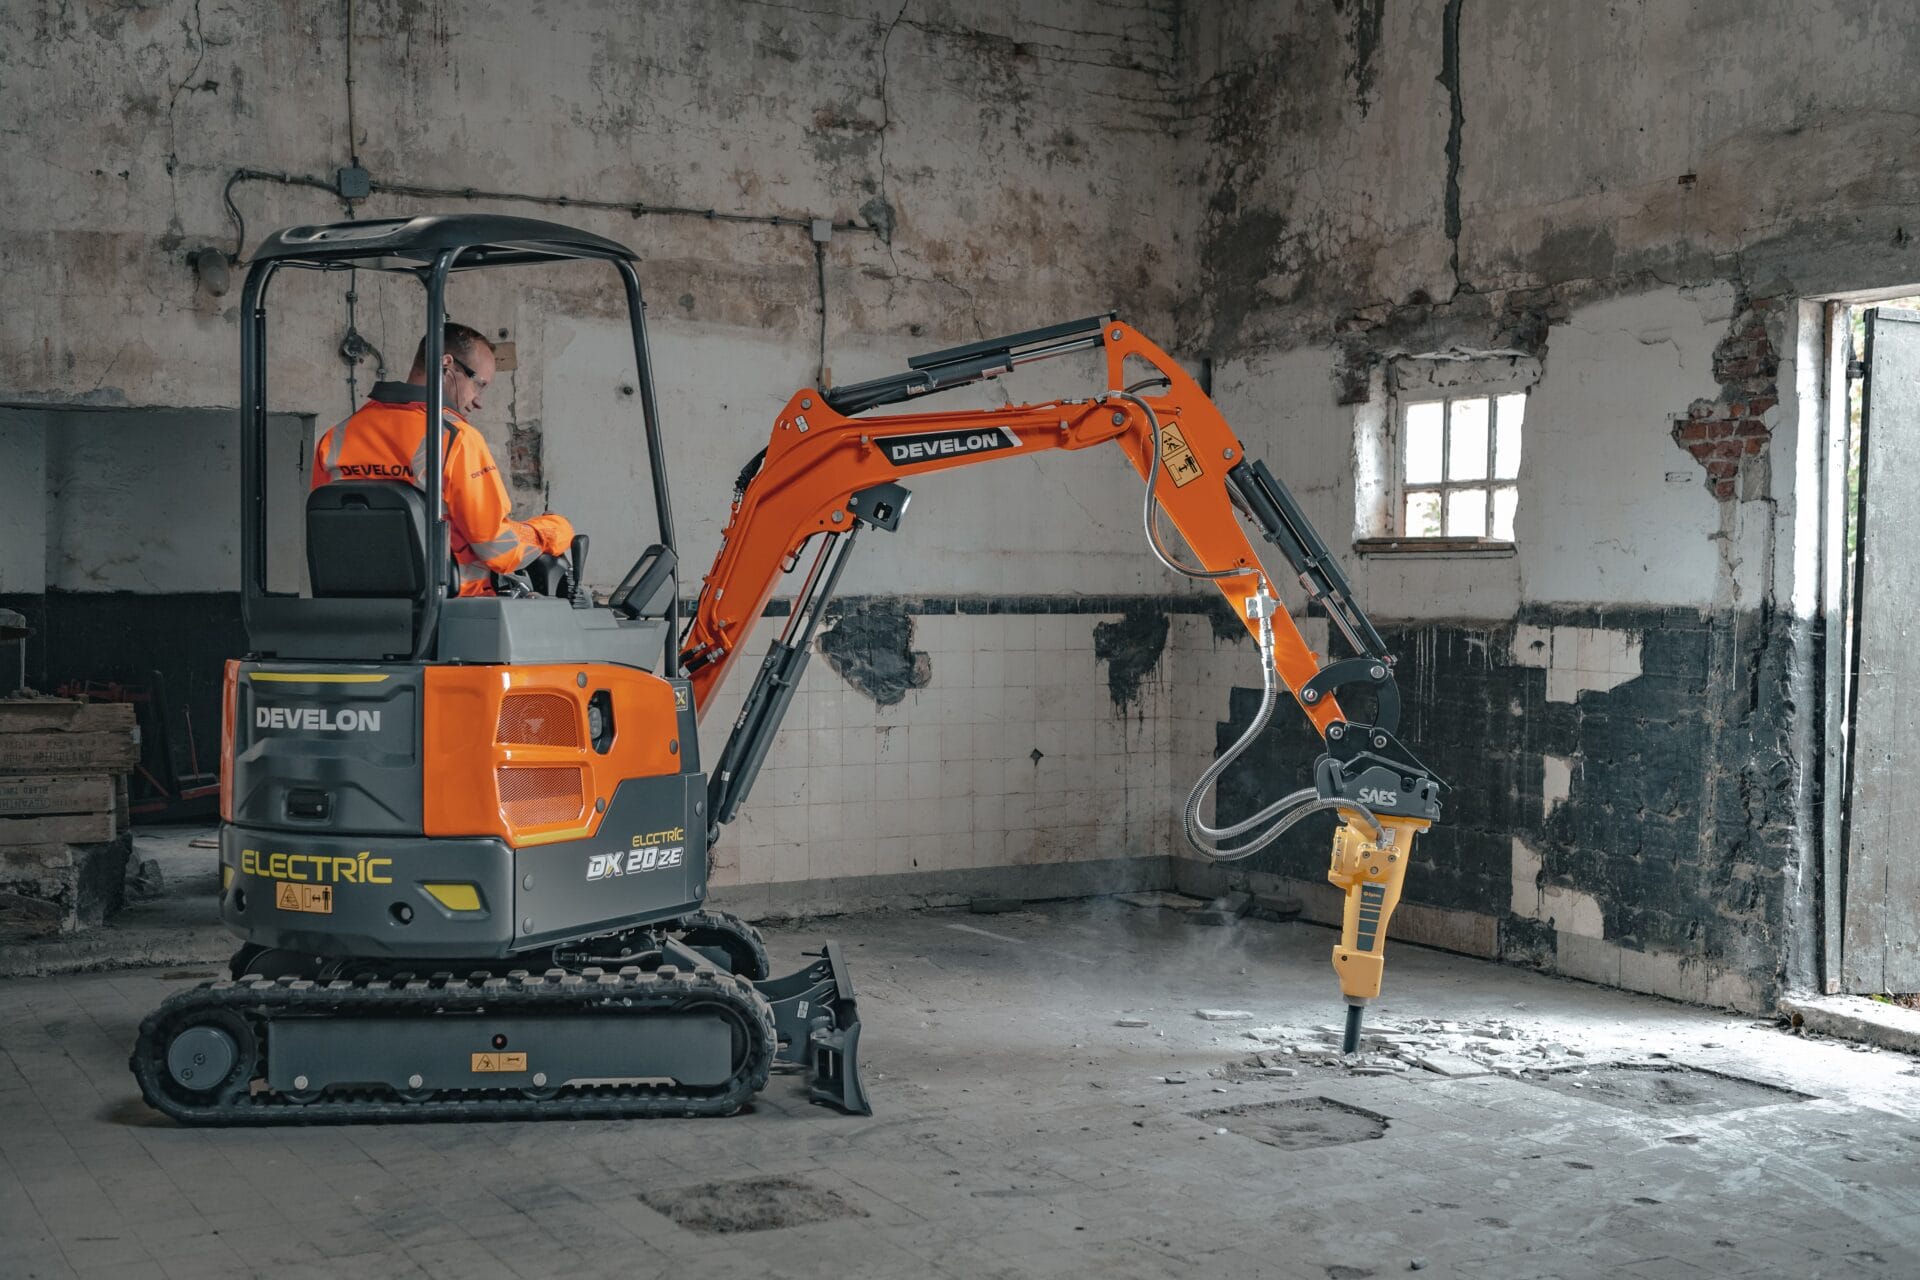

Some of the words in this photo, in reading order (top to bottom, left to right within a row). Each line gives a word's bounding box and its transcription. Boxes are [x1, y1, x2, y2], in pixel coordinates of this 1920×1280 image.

[892, 433, 998, 460] DEVELON
[339, 463, 414, 477] DEVELON
[256, 706, 381, 732] DEVELON
[1356, 787, 1397, 807] SAES
[241, 849, 393, 884] ELECTRIC
[586, 851, 625, 882] DX
